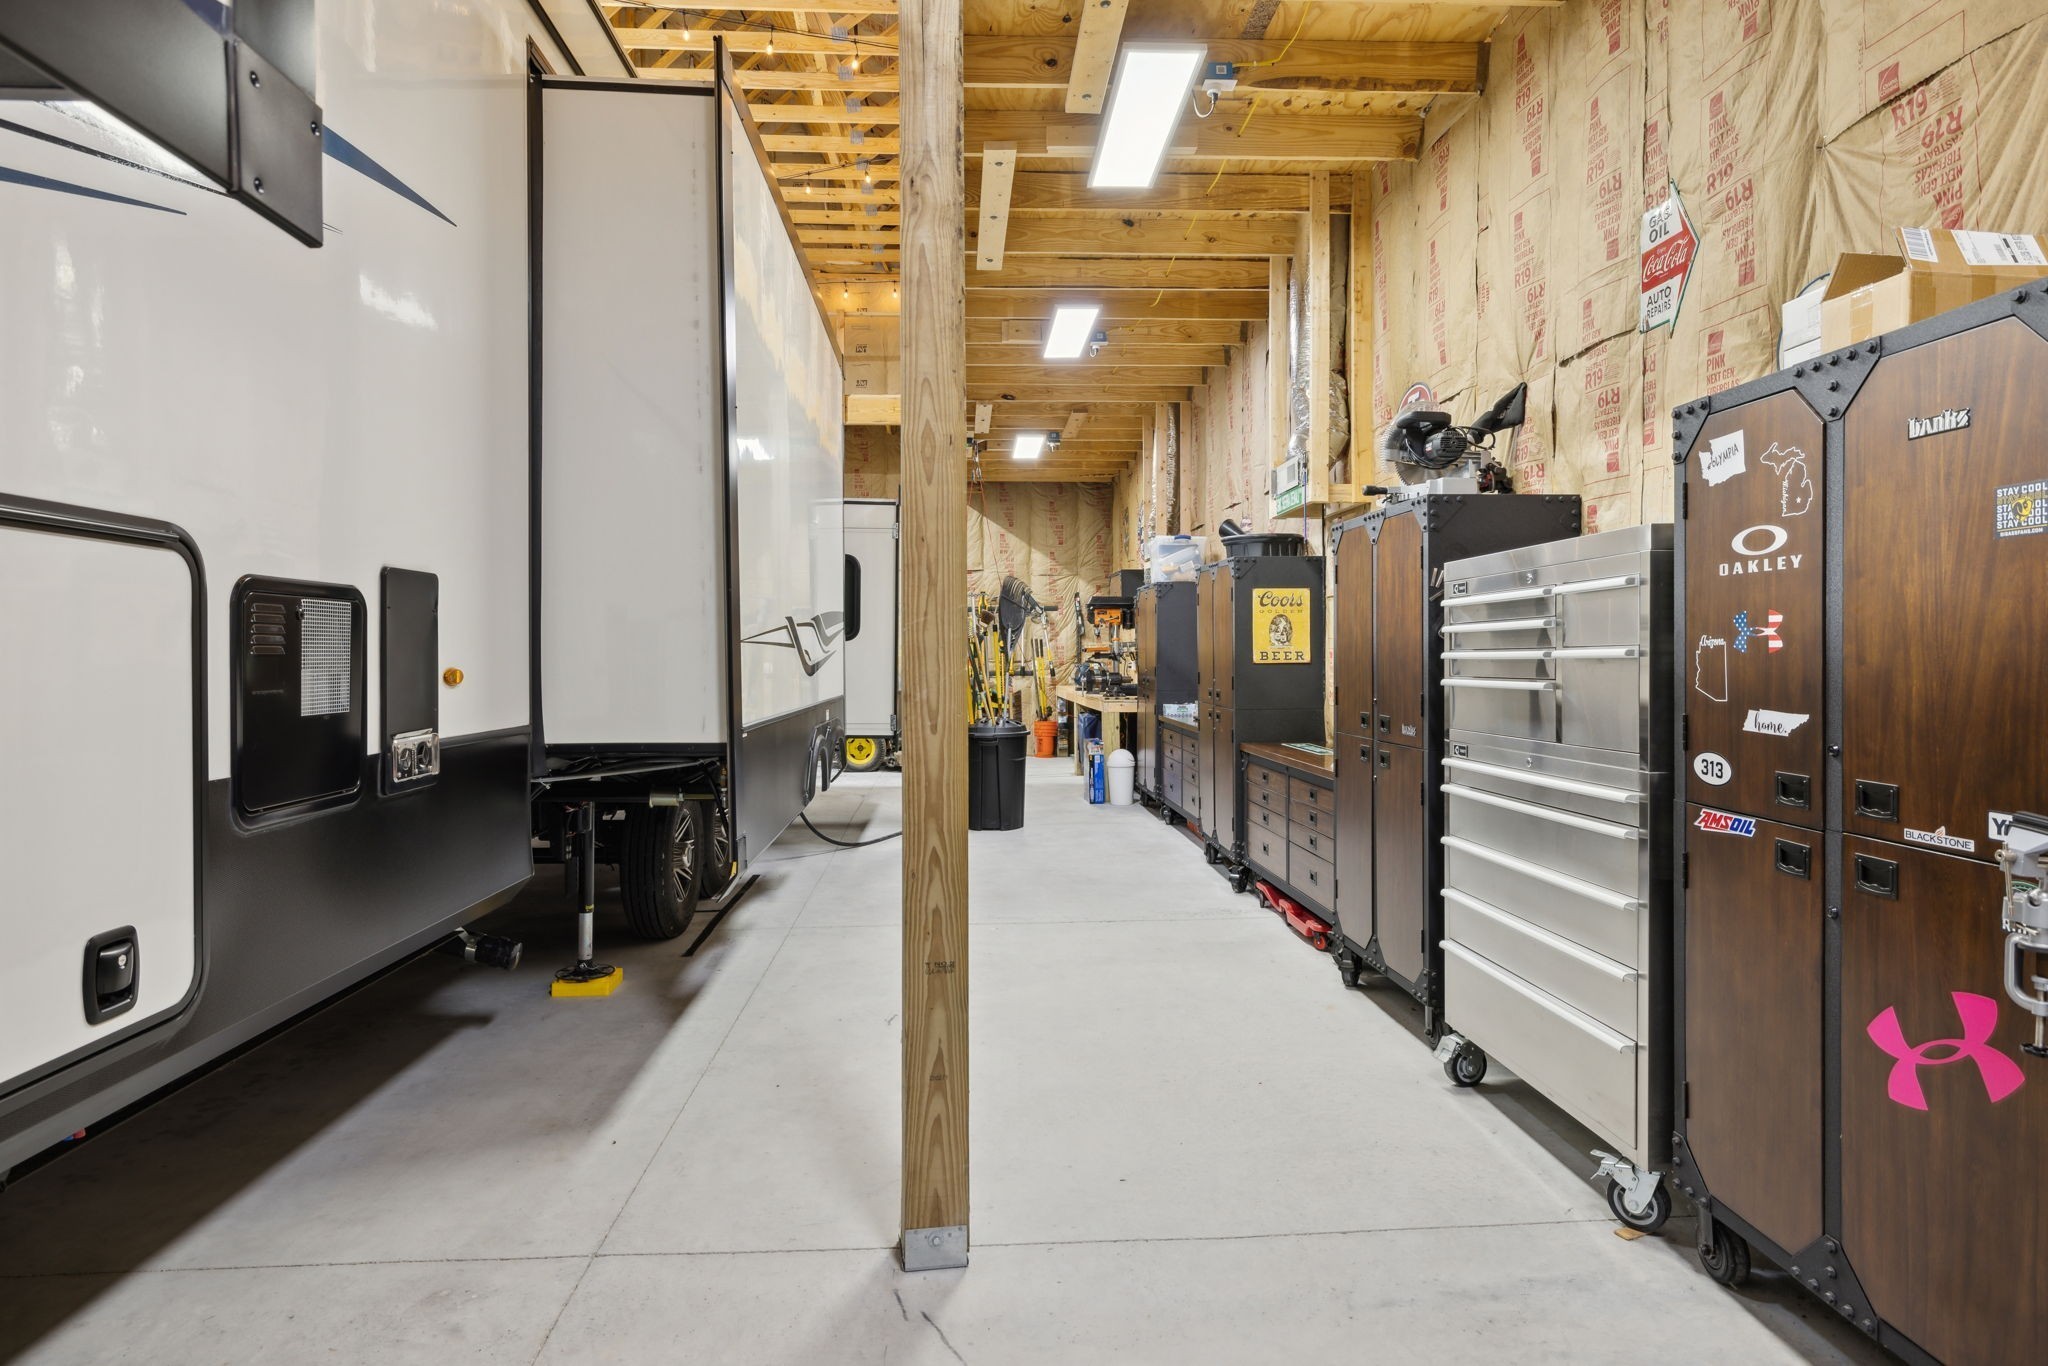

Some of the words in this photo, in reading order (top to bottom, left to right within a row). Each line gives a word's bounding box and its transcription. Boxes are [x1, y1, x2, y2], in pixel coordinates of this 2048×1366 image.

[1516, 87, 1530, 112] R19
[1891, 88, 1927, 131] R19
[1527, 98, 1543, 124] R19
[1708, 112, 1728, 138] PINK
[1921, 106, 1963, 149] R19
[1646, 143, 1662, 163] PINK
[1587, 159, 1604, 185] R19
[1706, 162, 1734, 195] R19
[1941, 165, 1963, 187] NEXT
[1599, 173, 1621, 199] R19
[1725, 178, 1753, 210] R19
[1920, 178, 1937, 197] GEN
[1933, 182, 1963, 210] PINK
[1603, 223, 1619, 241] PINK
[1649, 224, 1670, 244] OIL
[1735, 242, 1755, 262] PINK
[1515, 267, 1531, 289] R19
[1527, 282, 1545, 303] R19
[1647, 286, 1672, 309] AUTO
[1646, 299, 1672, 319] REPAIRS
[1707, 353, 1726, 372] PINK
[1585, 367, 1603, 390] R19
[1706, 371, 1721, 385] NEXT
[1722, 368, 1735, 379] GEN
[1598, 387, 1620, 409] R19
[1515, 445, 1528, 463] R19
[1604, 438, 1619, 452] PINK
[1711, 443, 1739, 468] OLYMPIA
[1523, 463, 1544, 480] R19
[1997, 486, 2019, 497] STAY
[2021, 482, 2048, 494] COOL
[1997, 503, 2012, 513] STA
[1997, 512, 2014, 522] STA
[1997, 520, 2019, 530] STAY
[2021, 515, 2048, 527] COOL
[1719, 554, 1802, 577] OAKLEY
[1258, 591, 1303, 607] Coors
[1700, 634, 1725, 649] Arizona
[1260, 651, 1305, 661] BEER
[1754, 711, 1788, 733] home.
[1701, 758, 1723, 779] 313
[1698, 810, 1754, 835] AMSOIL
[1905, 829, 1972, 850] BLACKSTONE
